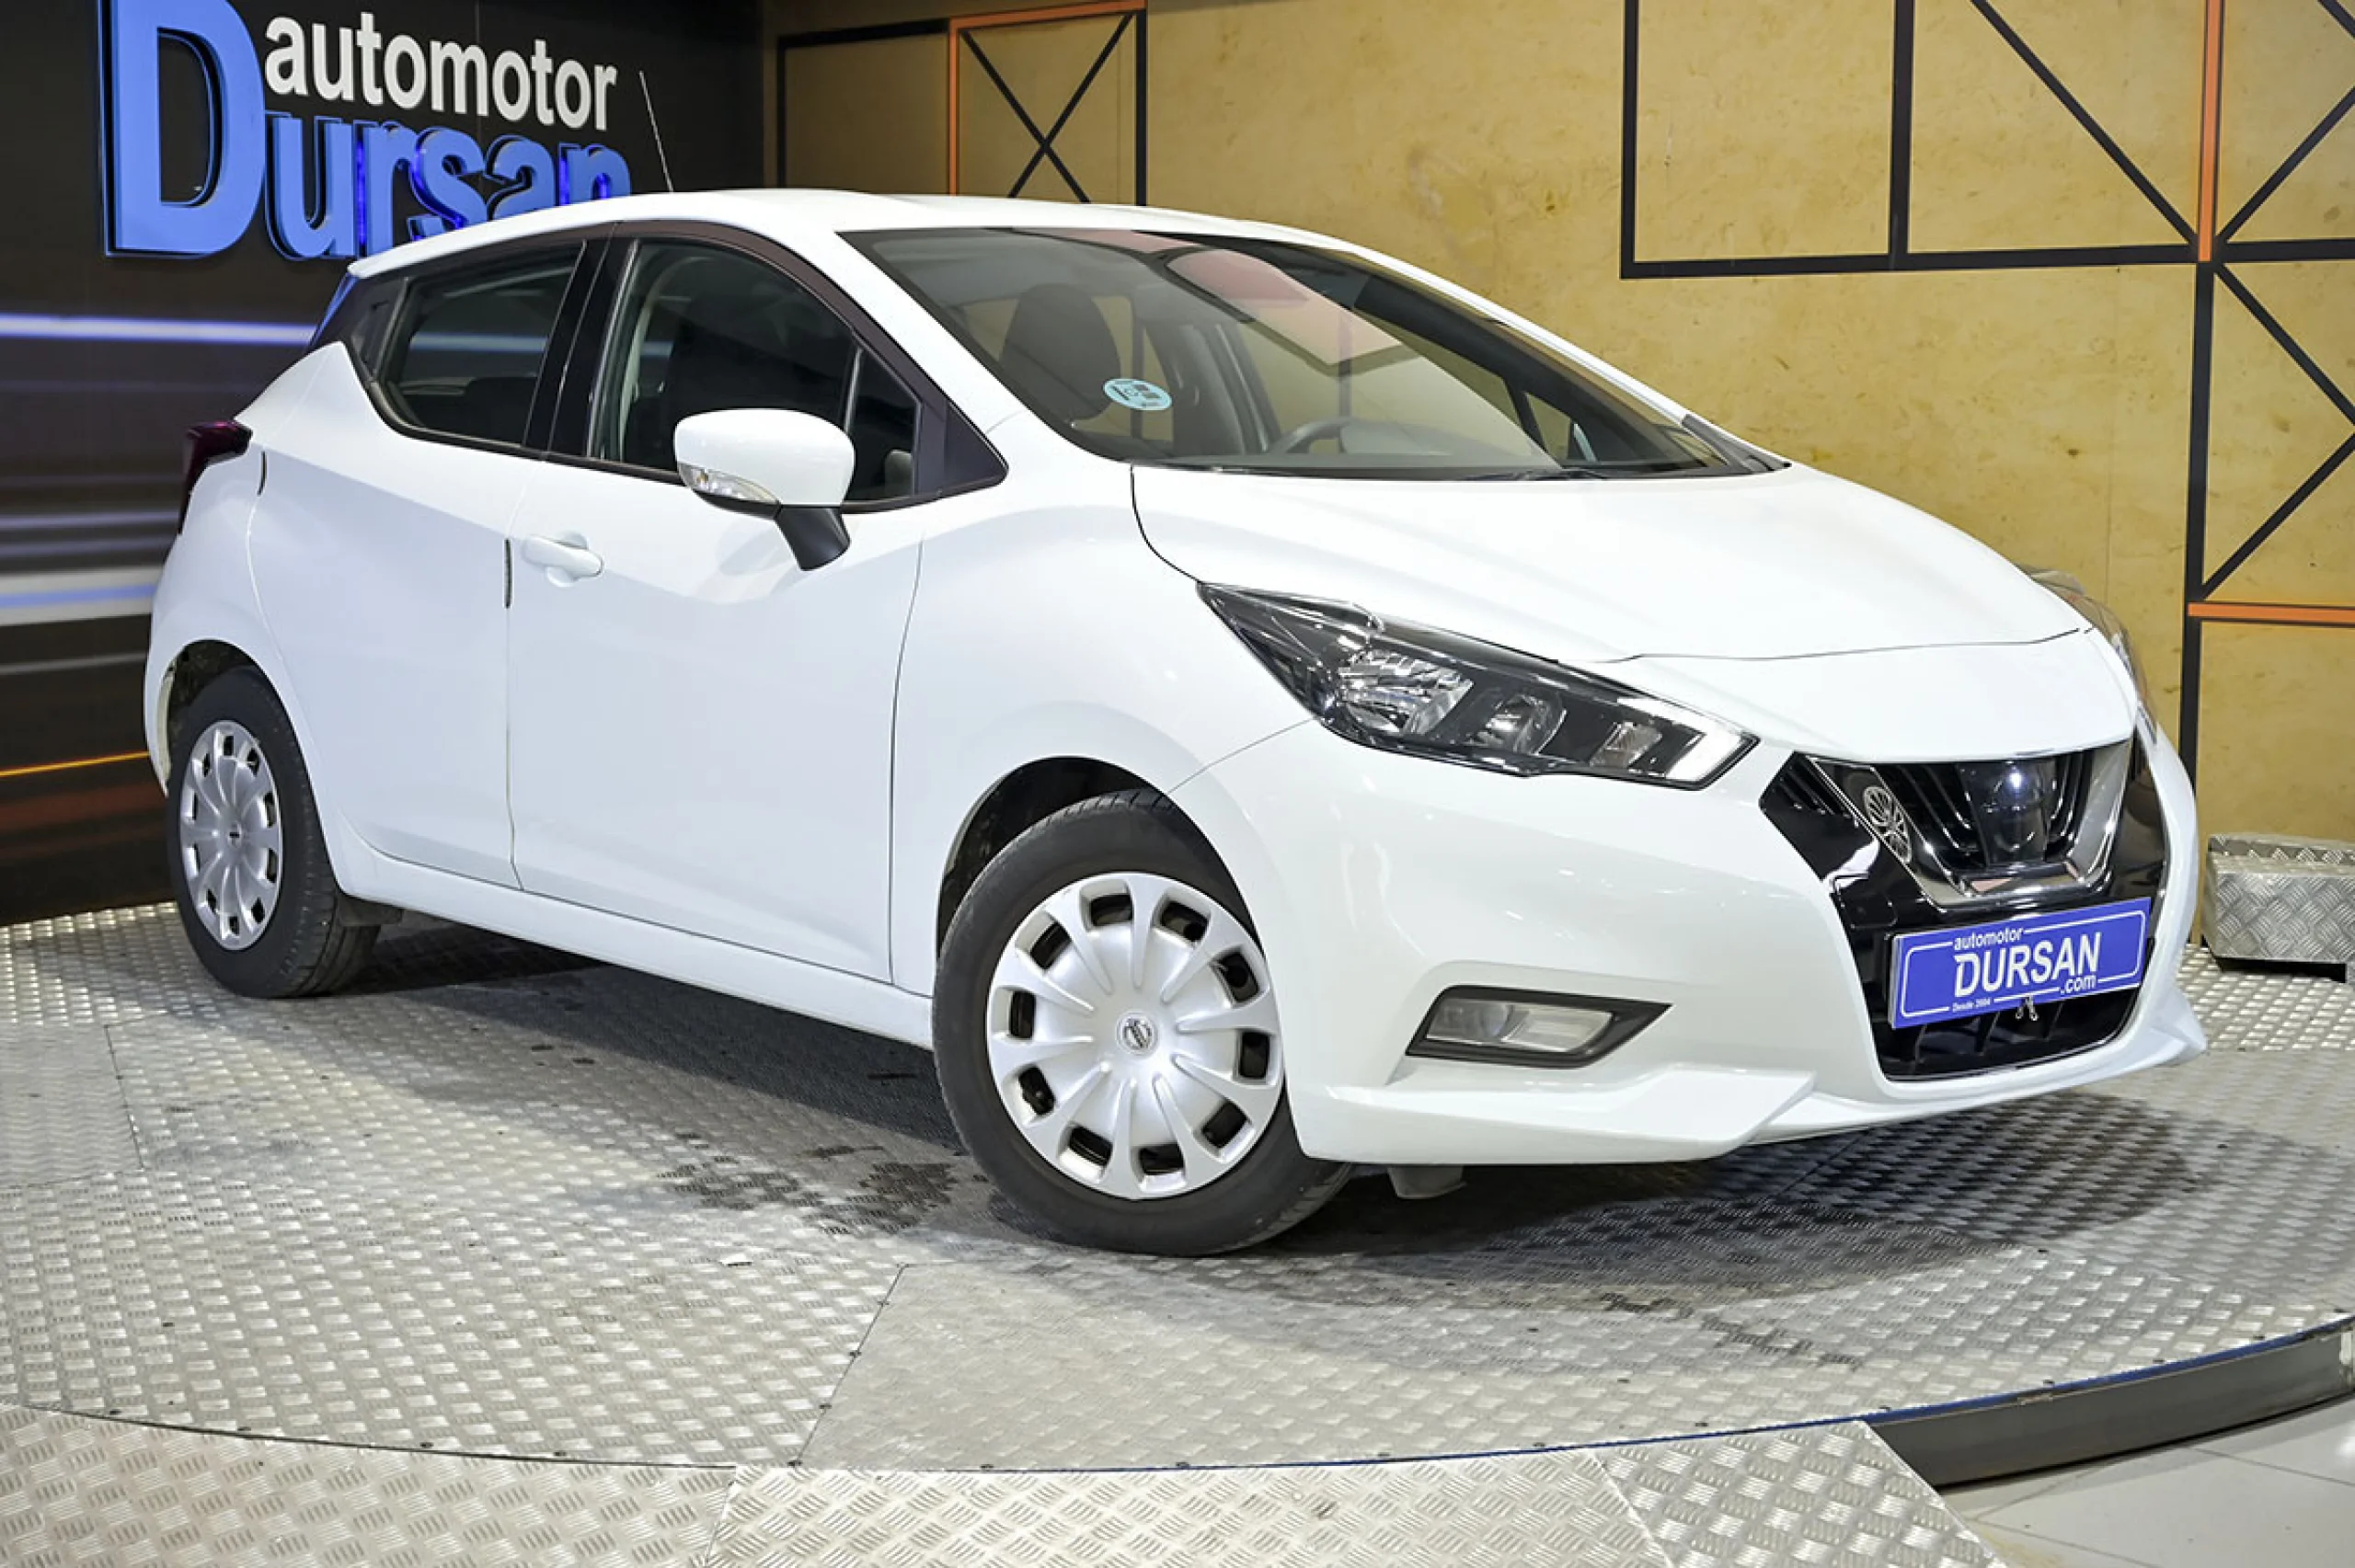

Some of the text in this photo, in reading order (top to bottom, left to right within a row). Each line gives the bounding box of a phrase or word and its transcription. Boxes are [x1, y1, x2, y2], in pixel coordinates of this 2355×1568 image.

[265, 12, 617, 131] automotor
[1954, 927, 2024, 951] automotor
[1953, 932, 2102, 998] DURSAN
[2060, 975, 2097, 996] .com
